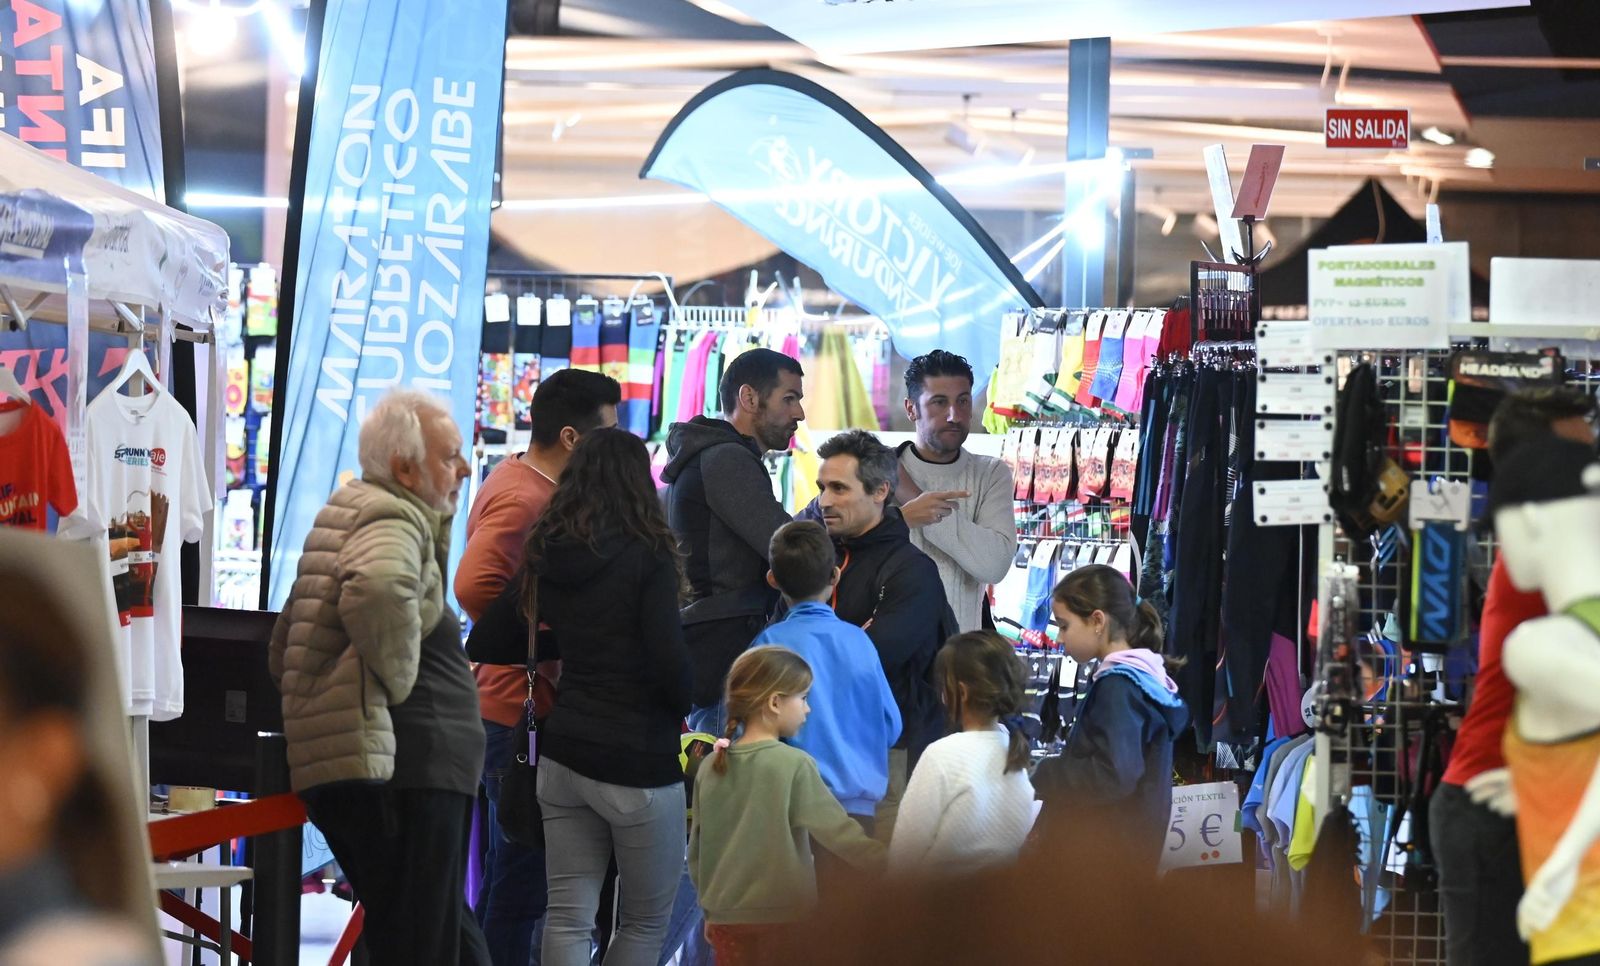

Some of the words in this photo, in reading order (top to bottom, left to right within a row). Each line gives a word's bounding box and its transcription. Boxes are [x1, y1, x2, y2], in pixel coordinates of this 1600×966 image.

[1328, 118, 1351, 139] SIN
[1355, 118, 1406, 139] SALIDA
[1195, 793, 1227, 801] TEXTIL
[1199, 813, 1225, 847] €
